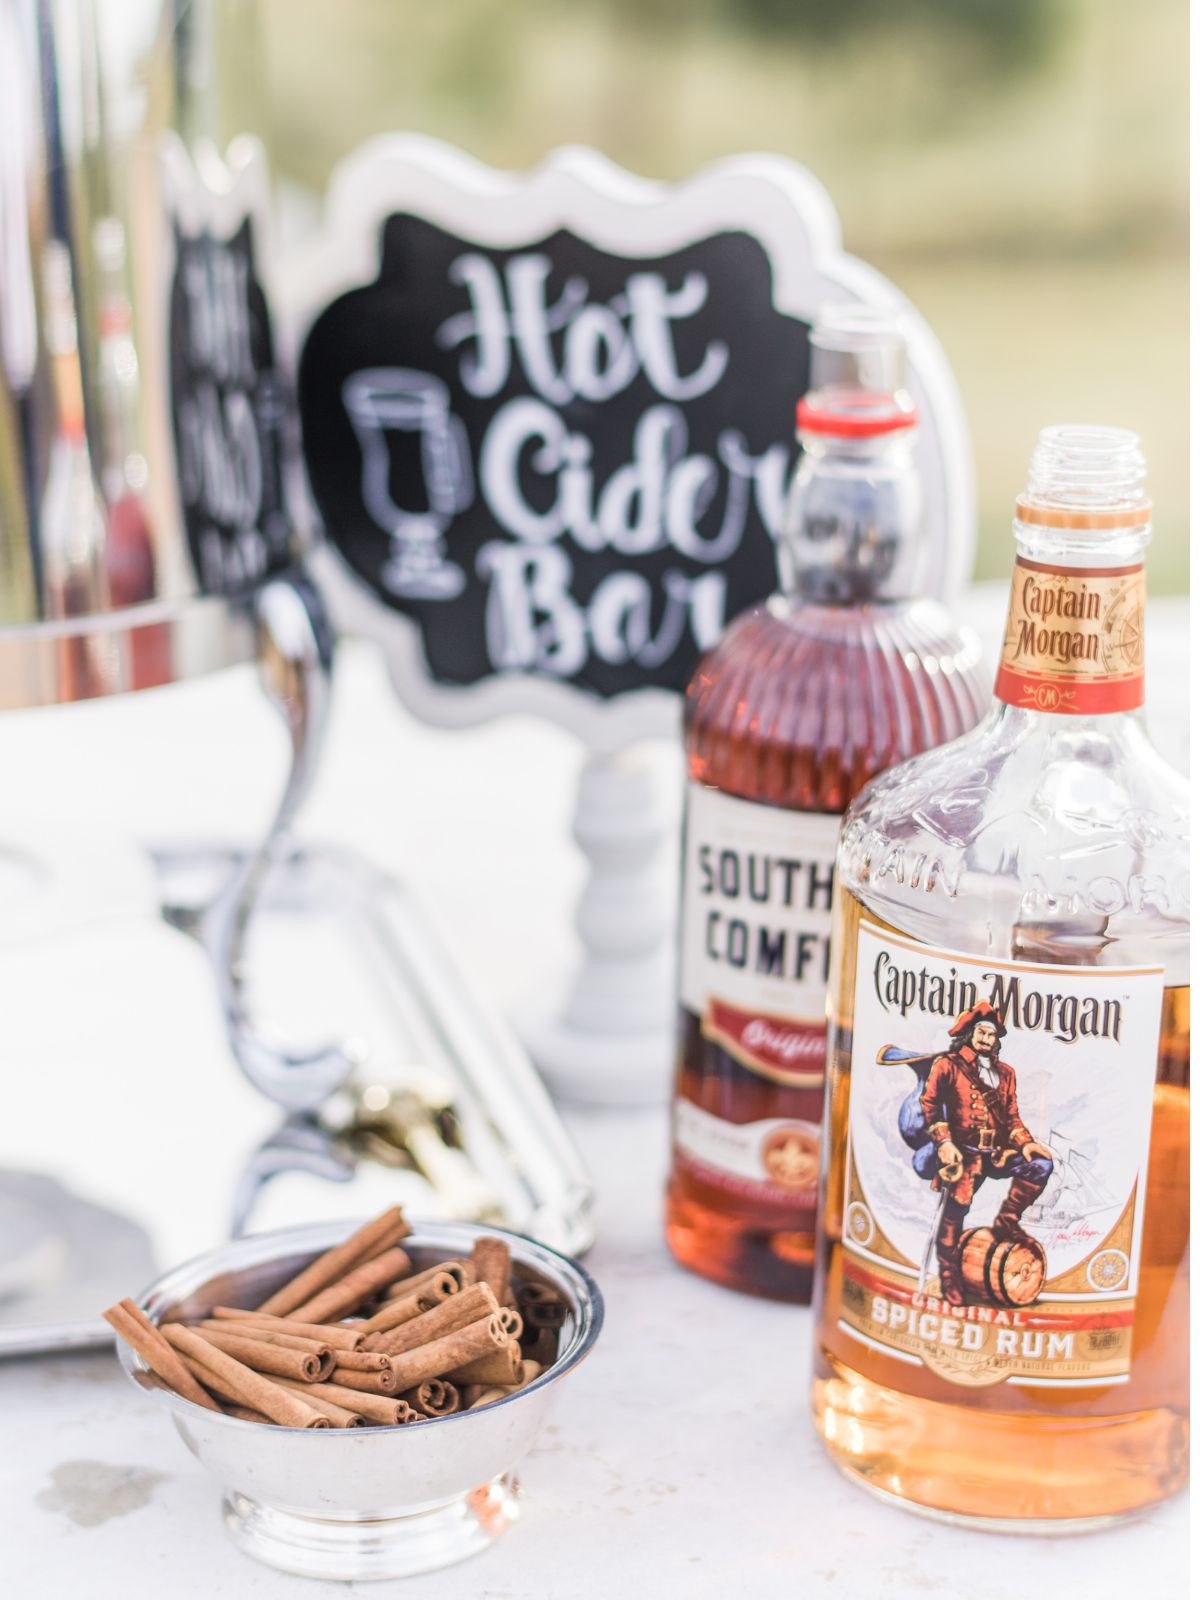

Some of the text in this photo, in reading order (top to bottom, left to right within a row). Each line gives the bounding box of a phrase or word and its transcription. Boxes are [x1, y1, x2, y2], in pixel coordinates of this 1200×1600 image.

[436, 253, 729, 405] Hot
[480, 394, 790, 563] Cider
[476, 538, 728, 678] Bar
[1022, 576, 1101, 622] Captain
[1013, 619, 1100, 665] Morgan
[706, 911, 831, 982] COMF
[873, 951, 978, 1018] Captain
[982, 973, 1122, 1043] Morgan
[871, 1296, 984, 1351] SPICED
[997, 1330, 1075, 1360] RUM
[912, 1293, 1025, 1327] ORIGINAL
